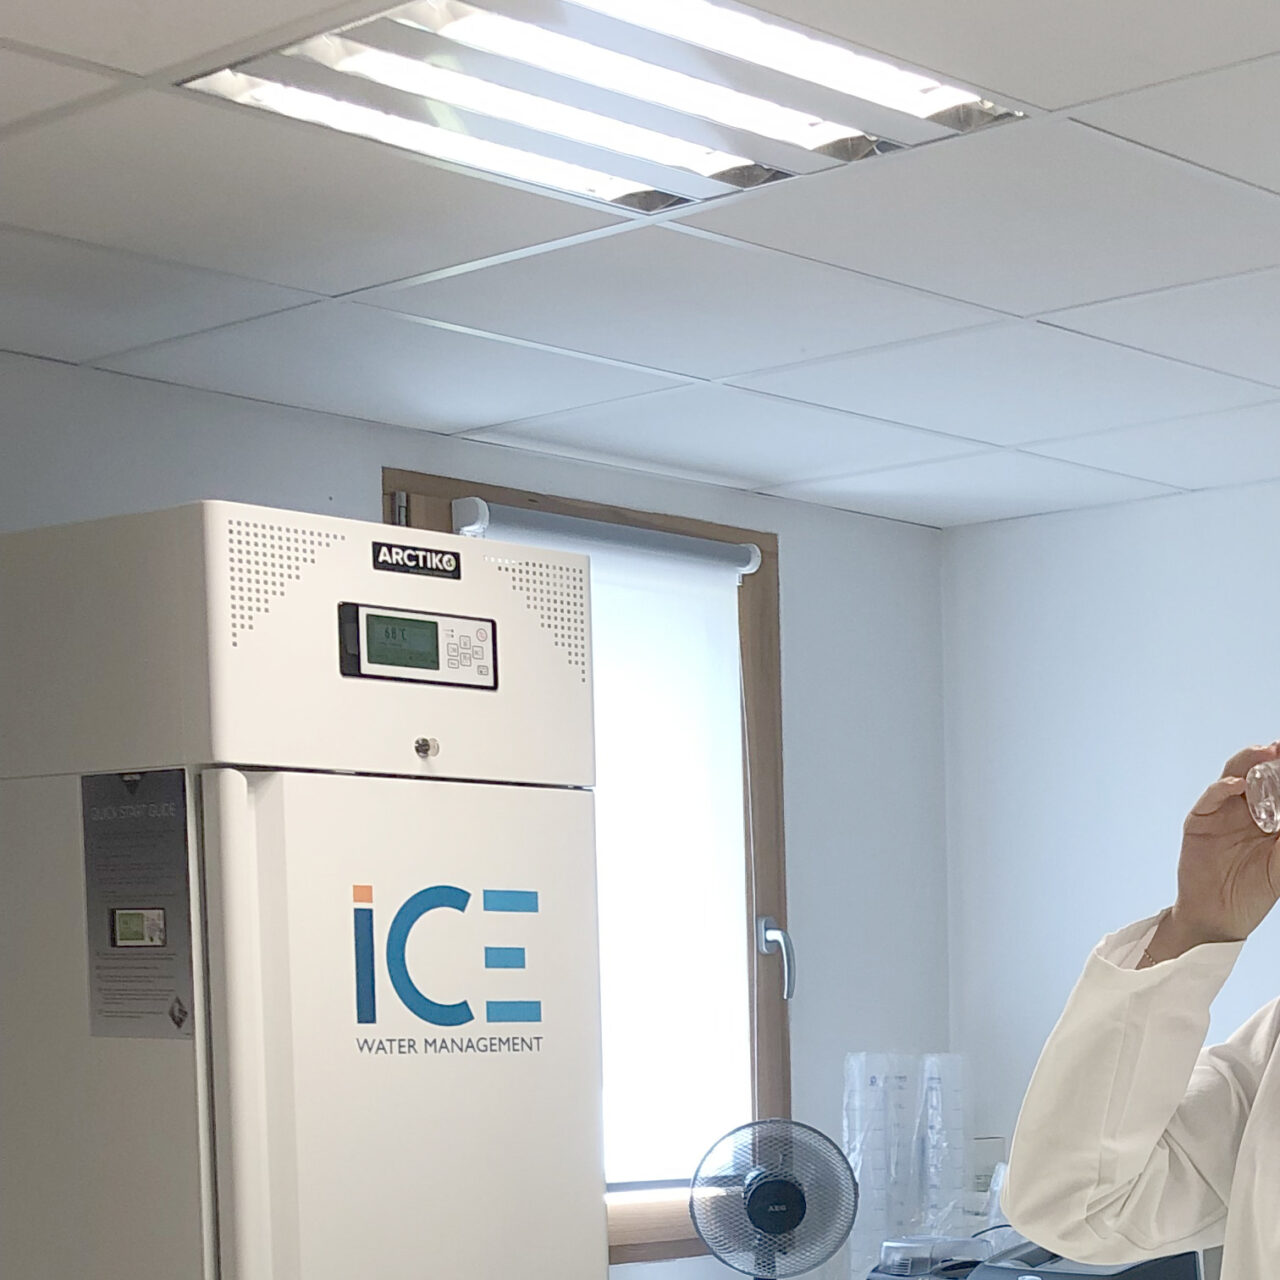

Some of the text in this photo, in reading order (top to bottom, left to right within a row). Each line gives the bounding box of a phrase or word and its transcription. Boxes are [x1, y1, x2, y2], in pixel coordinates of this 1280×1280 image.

[378, 546, 456, 571] ARCTIKO
[356, 1036, 543, 1054] WATER MANAGEMENT
